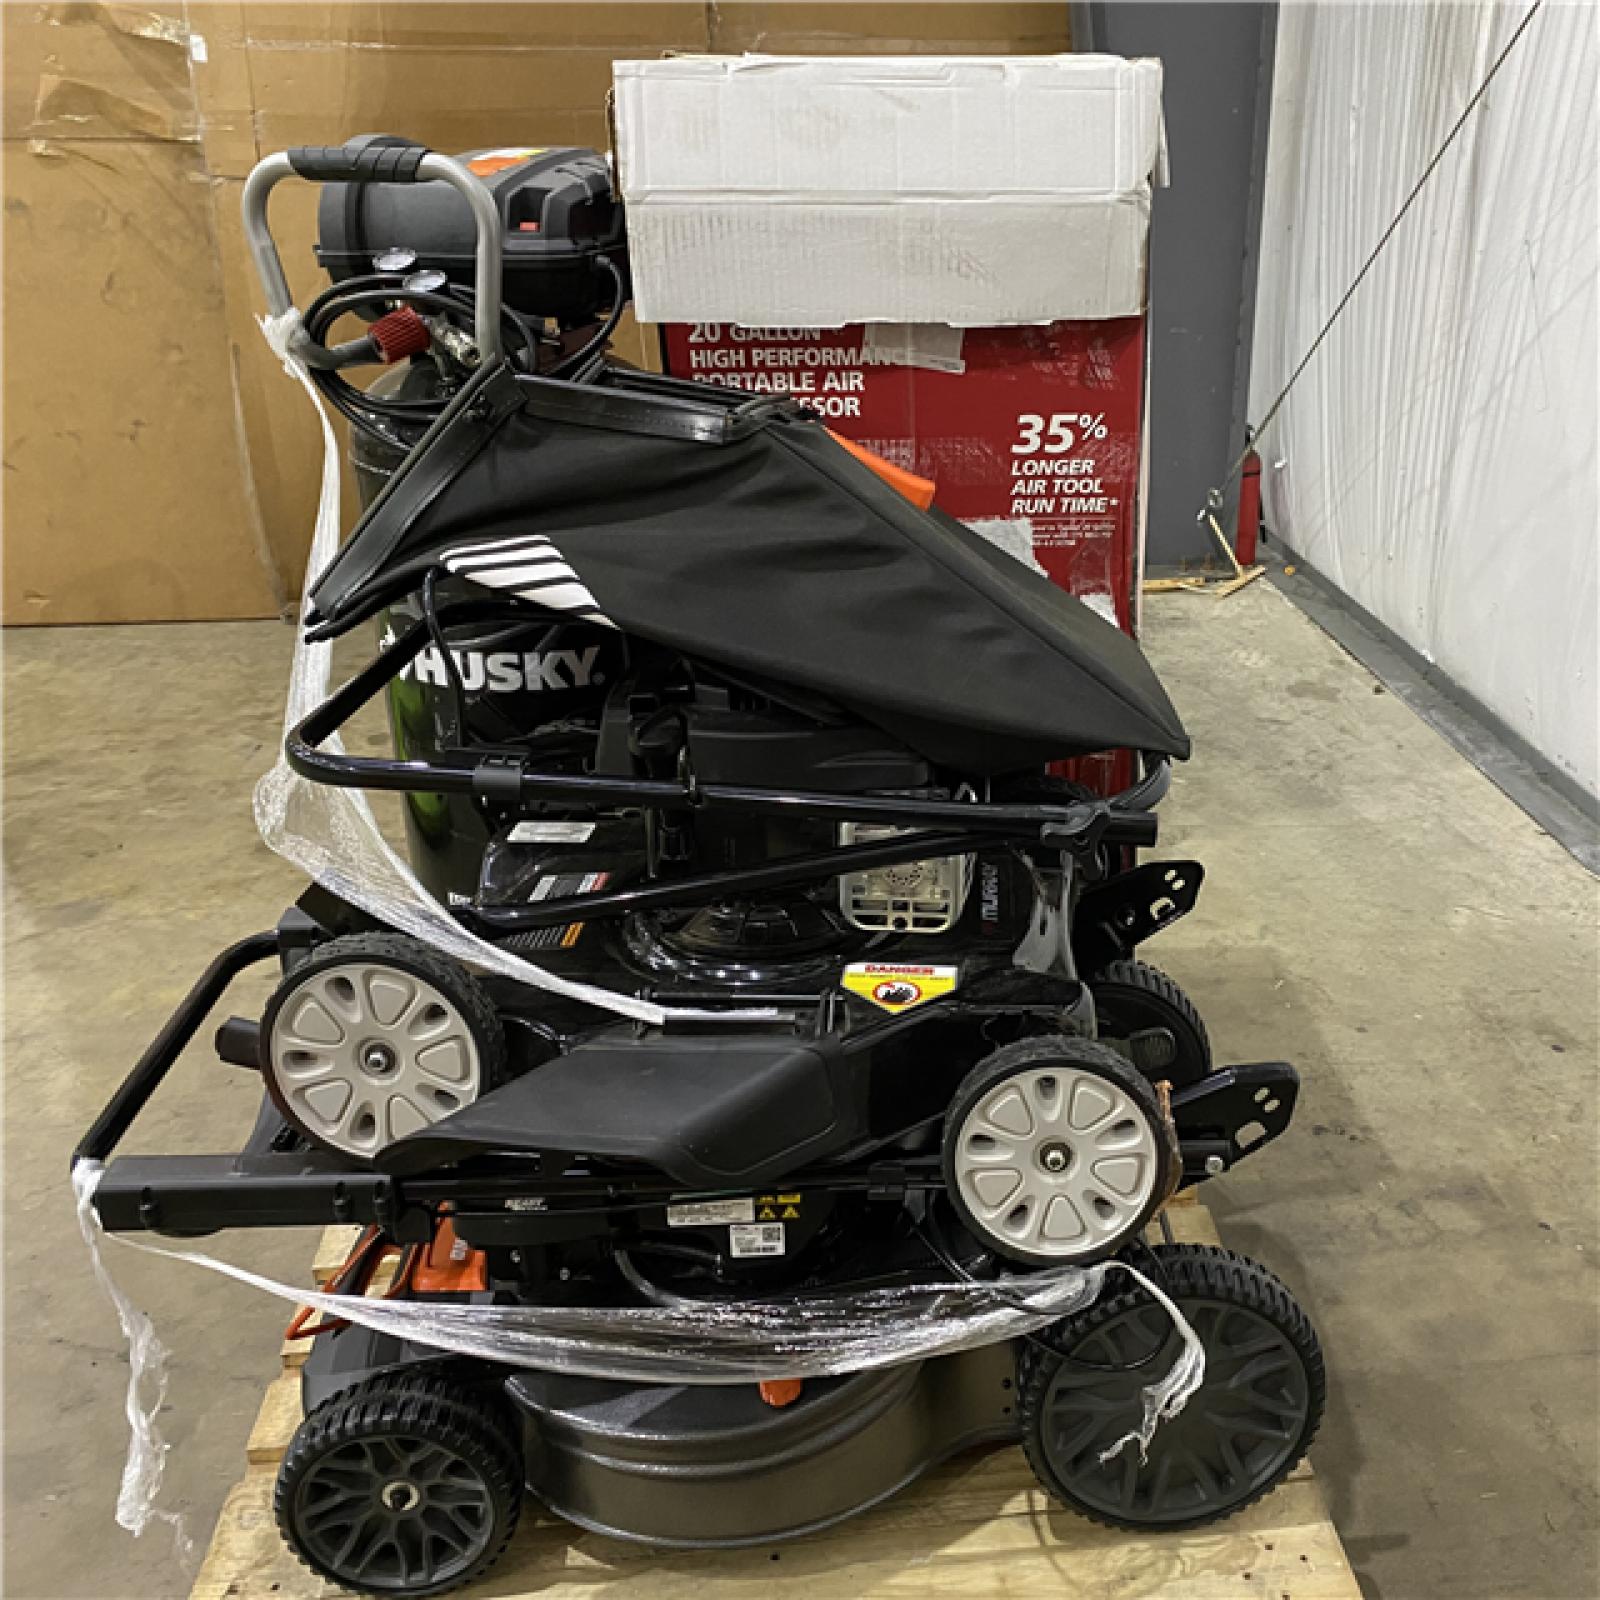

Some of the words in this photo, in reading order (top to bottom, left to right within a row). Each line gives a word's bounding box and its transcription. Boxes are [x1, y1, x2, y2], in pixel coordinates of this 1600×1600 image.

[688, 322, 721, 343] 20
[689, 349, 746, 369] HIGH
[821, 371, 866, 391] AIR
[1010, 412, 1109, 454] 35%
[1010, 459, 1096, 476] LONGER
[1009, 479, 1048, 496] AIR
[1052, 478, 1104, 494] TOOL
[1011, 498, 1056, 514] RUN
